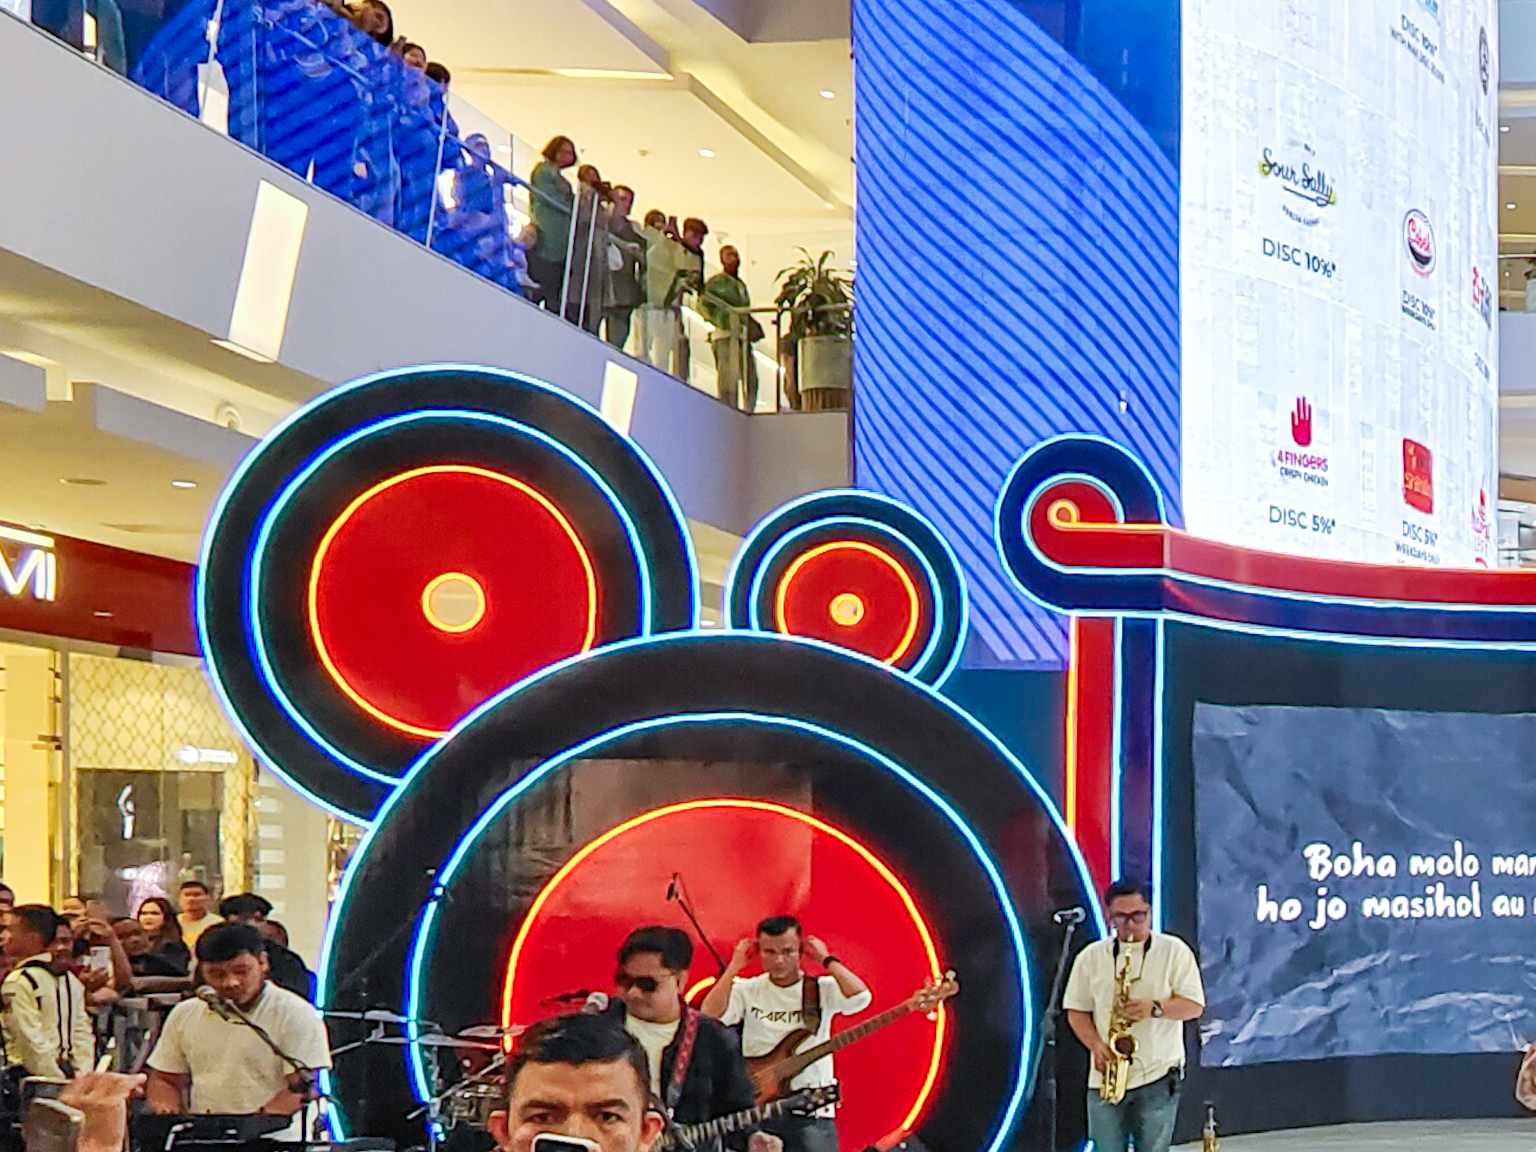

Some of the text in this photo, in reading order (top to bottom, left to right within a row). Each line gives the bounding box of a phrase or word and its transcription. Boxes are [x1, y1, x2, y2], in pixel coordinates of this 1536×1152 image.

[1261, 147, 1336, 205] Sour Sally
[1262, 237, 1302, 267] DISC
[1269, 504, 1308, 530] DISC
[1402, 520, 1423, 543] DISC
[1303, 841, 1397, 882] Boha
[1409, 839, 1480, 878] molo
[1256, 883, 1302, 923] ho
[1308, 886, 1347, 930] jo
[1362, 880, 1482, 919] masihol
[1492, 894, 1525, 918] au
